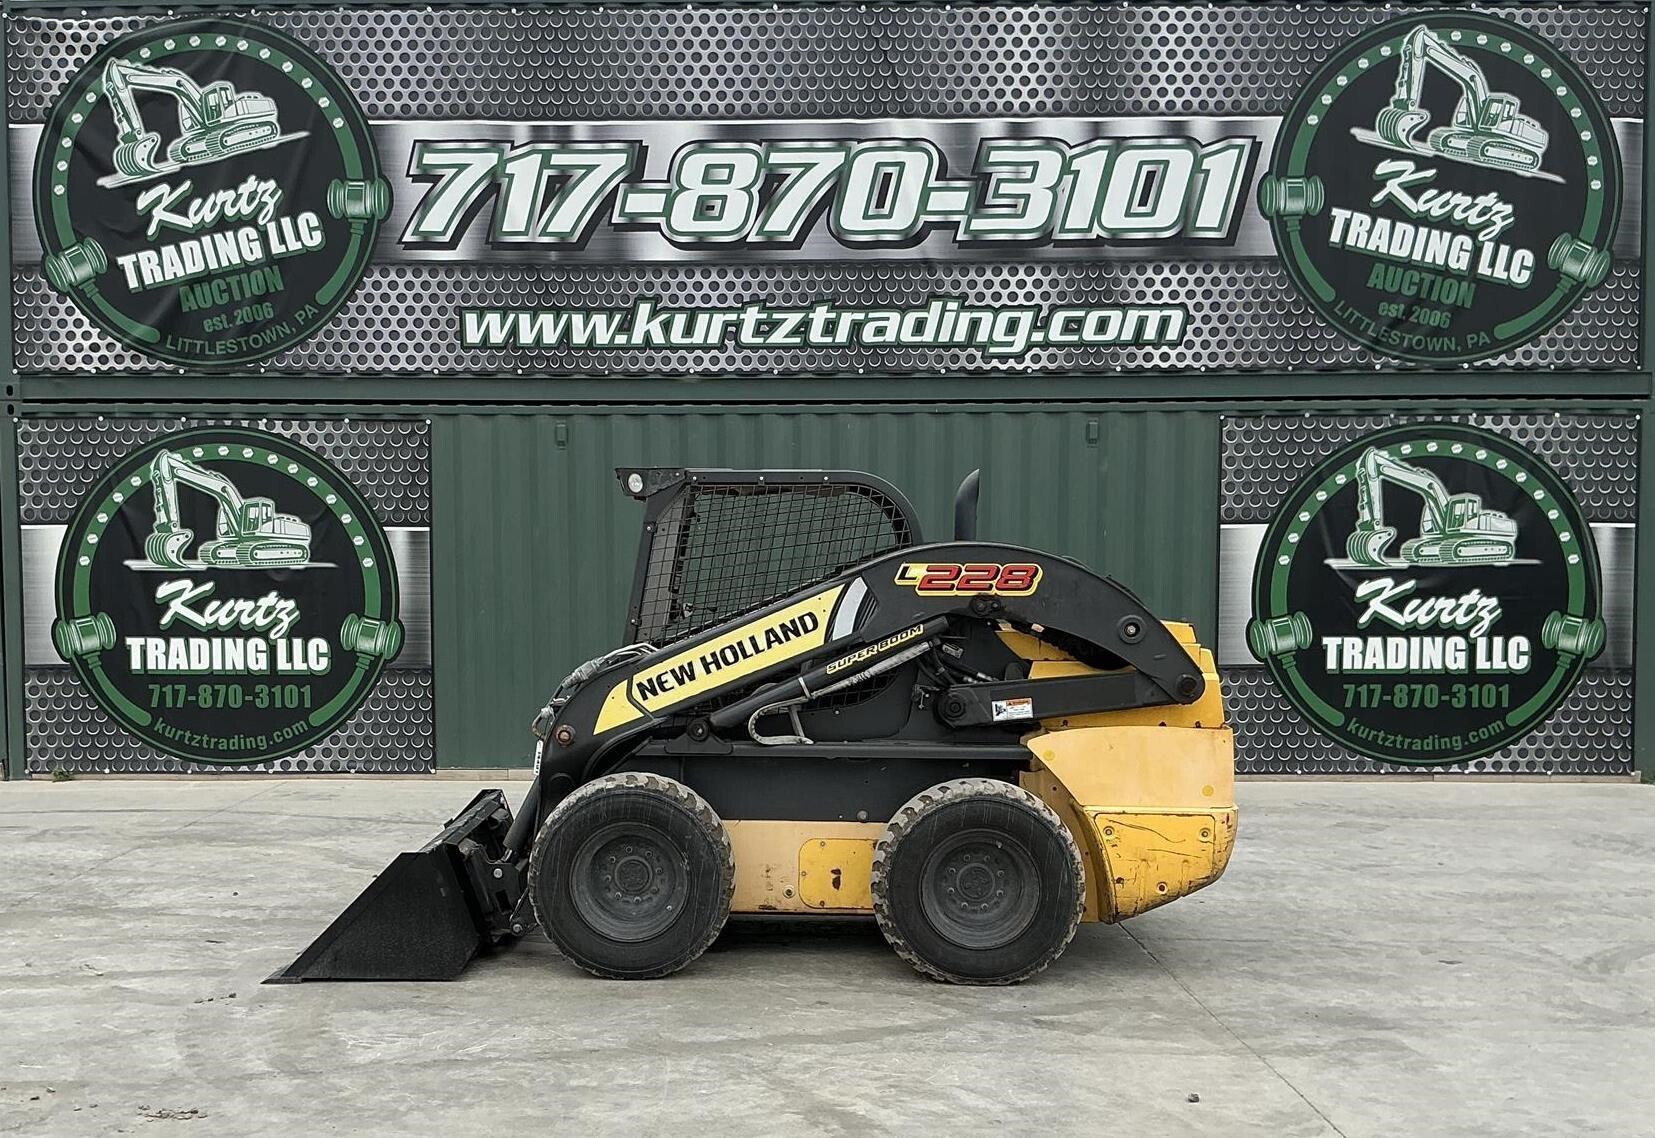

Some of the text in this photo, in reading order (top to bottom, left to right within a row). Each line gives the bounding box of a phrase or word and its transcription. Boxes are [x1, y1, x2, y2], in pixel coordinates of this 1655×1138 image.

[137, 175, 282, 240] Kurtz
[403, 139, 1252, 248] 717-870-3101
[1371, 159, 1515, 240] Kurtz
[117, 212, 326, 291] TRADING LLC
[1328, 208, 1536, 286] TRADING LLC
[178, 265, 285, 312] AUCTION
[1366, 262, 1477, 309] AUCTION
[166, 304, 319, 355] LITTLESTOWN, PA
[203, 302, 275, 333] est. 2006
[461, 299, 1187, 354] www.kurtztrading.com
[1334, 300, 1491, 352] LITTLESTOWN, PA
[1378, 302, 1452, 329] est. 2006
[894, 562, 1043, 597] L228
[155, 578, 301, 640] Kurtz
[1356, 576, 1503, 639] Kurtz
[126, 638, 332, 674] TRADING LLC
[636, 611, 819, 701] NEW HOLLAND
[827, 624, 924, 674] SUPER BOOM
[1322, 636, 1531, 674] TRADING LLC
[148, 683, 312, 710] 717-870-3101
[1342, 682, 1510, 709] 717-870-3101
[153, 717, 309, 751] kurtztrading.com
[1347, 716, 1506, 751] kurtztrading.com
